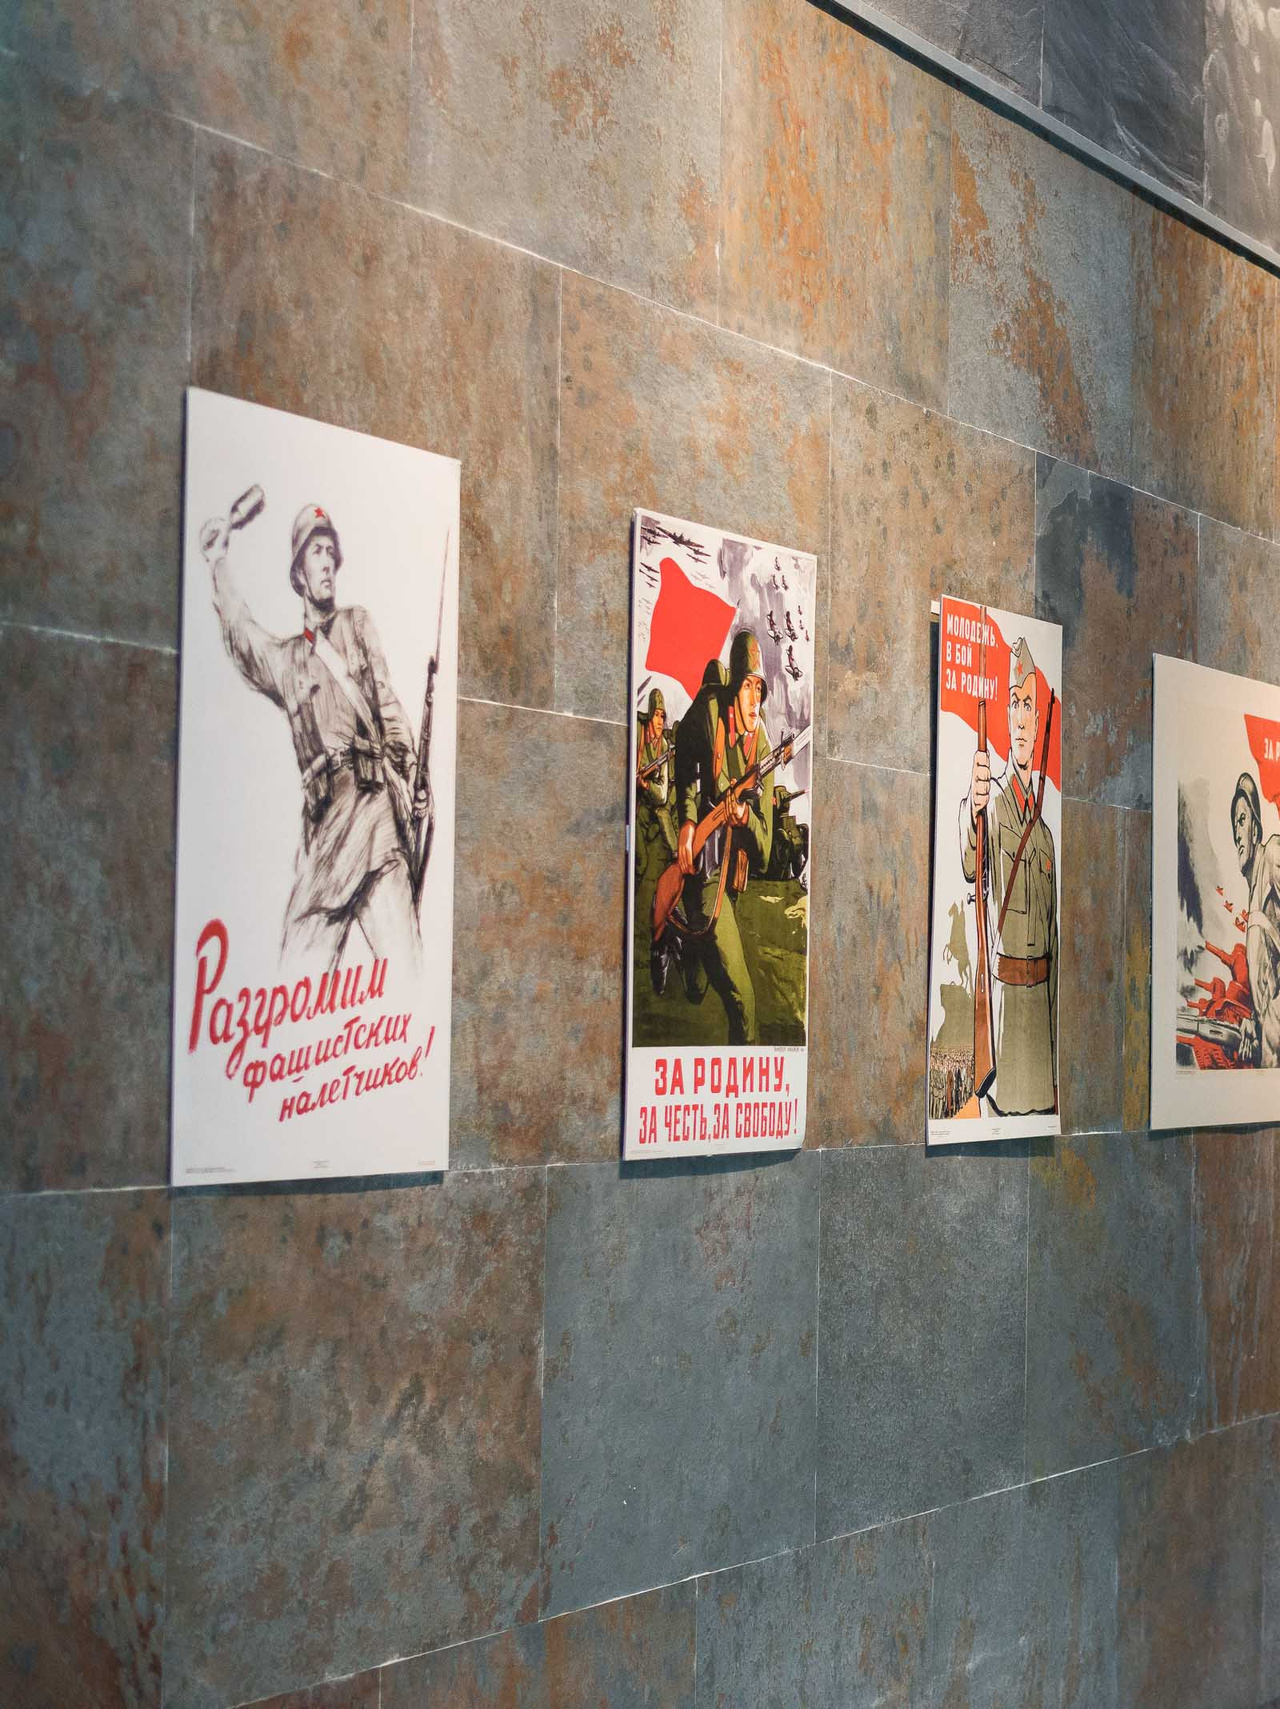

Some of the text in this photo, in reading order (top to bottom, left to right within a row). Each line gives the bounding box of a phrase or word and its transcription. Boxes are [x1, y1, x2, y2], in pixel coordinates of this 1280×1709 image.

[946, 613, 999, 649] МОЛОДЕЖЬ,
[946, 641, 972, 668] В БОЙ
[945, 668, 998, 701] ЗА РОДИНУ!
[1264, 738, 1274, 761] ЗА
[188, 918, 388, 1079] Разгромим
[243, 1012, 413, 1103] фашистских
[278, 1025, 436, 1123] налетчиков!
[654, 1056, 790, 1099] ЗА РОДИНУ,
[639, 1098, 798, 1144] ЗА ЧЕСТЬ, ЗА СВОБОДУ!
